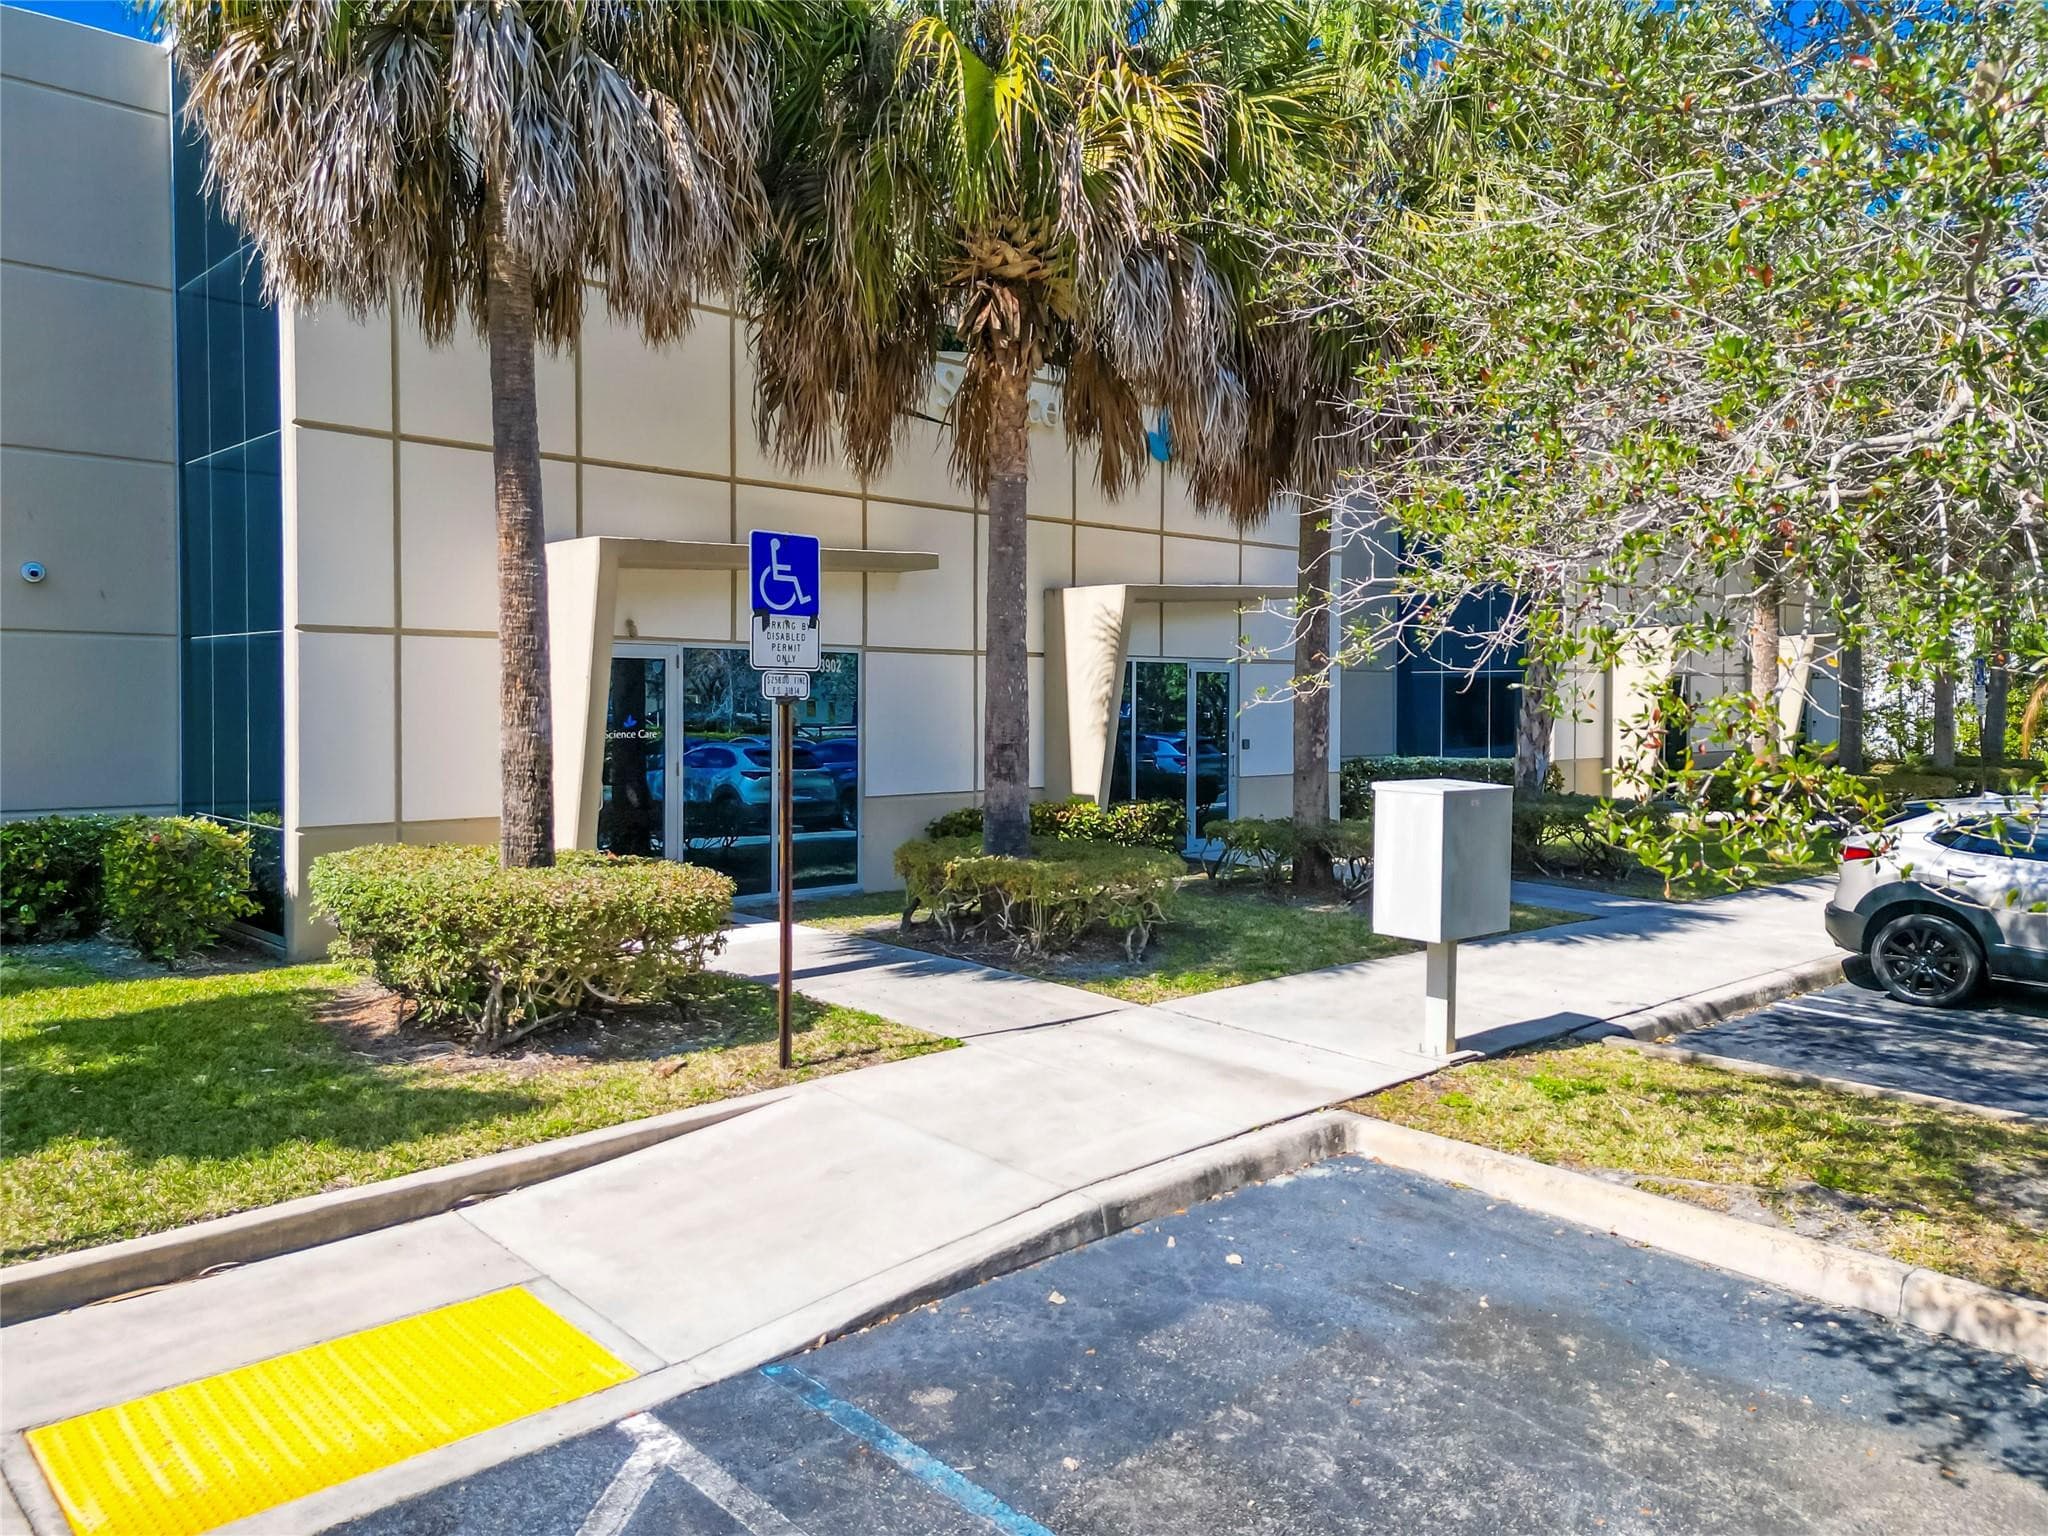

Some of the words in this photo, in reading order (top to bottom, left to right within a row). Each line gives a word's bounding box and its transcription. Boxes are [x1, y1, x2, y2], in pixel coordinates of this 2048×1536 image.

[766, 632, 806, 642] DISABLED
[771, 643, 801, 652] PERMIT
[776, 654, 796, 663] ONLY
[820, 658, 842, 673] 3902
[604, 729, 636, 739] Science
[638, 729, 658, 739] Care
